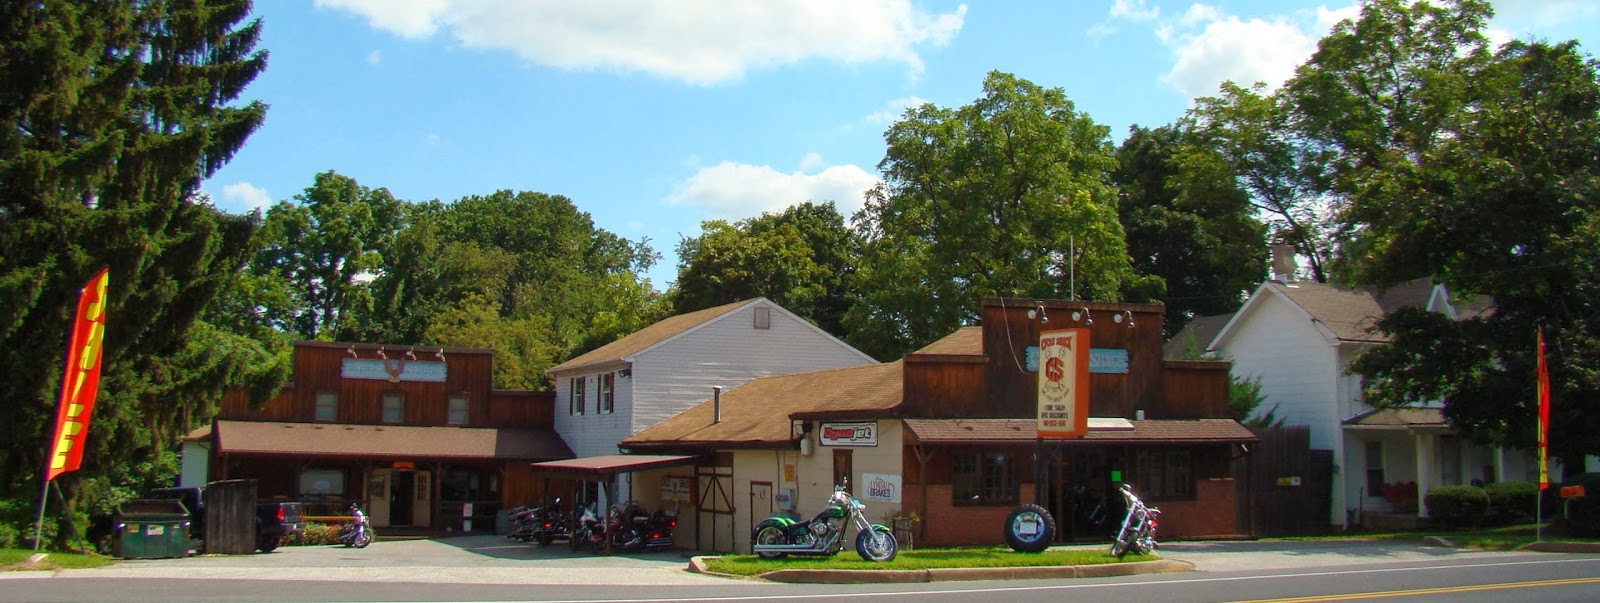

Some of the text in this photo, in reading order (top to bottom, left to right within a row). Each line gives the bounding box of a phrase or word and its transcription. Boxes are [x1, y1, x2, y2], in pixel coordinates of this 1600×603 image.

[1041, 338, 1055, 351] CYCLE
[51, 271, 109, 469] SALE
[870, 488, 890, 498] BRAKES
